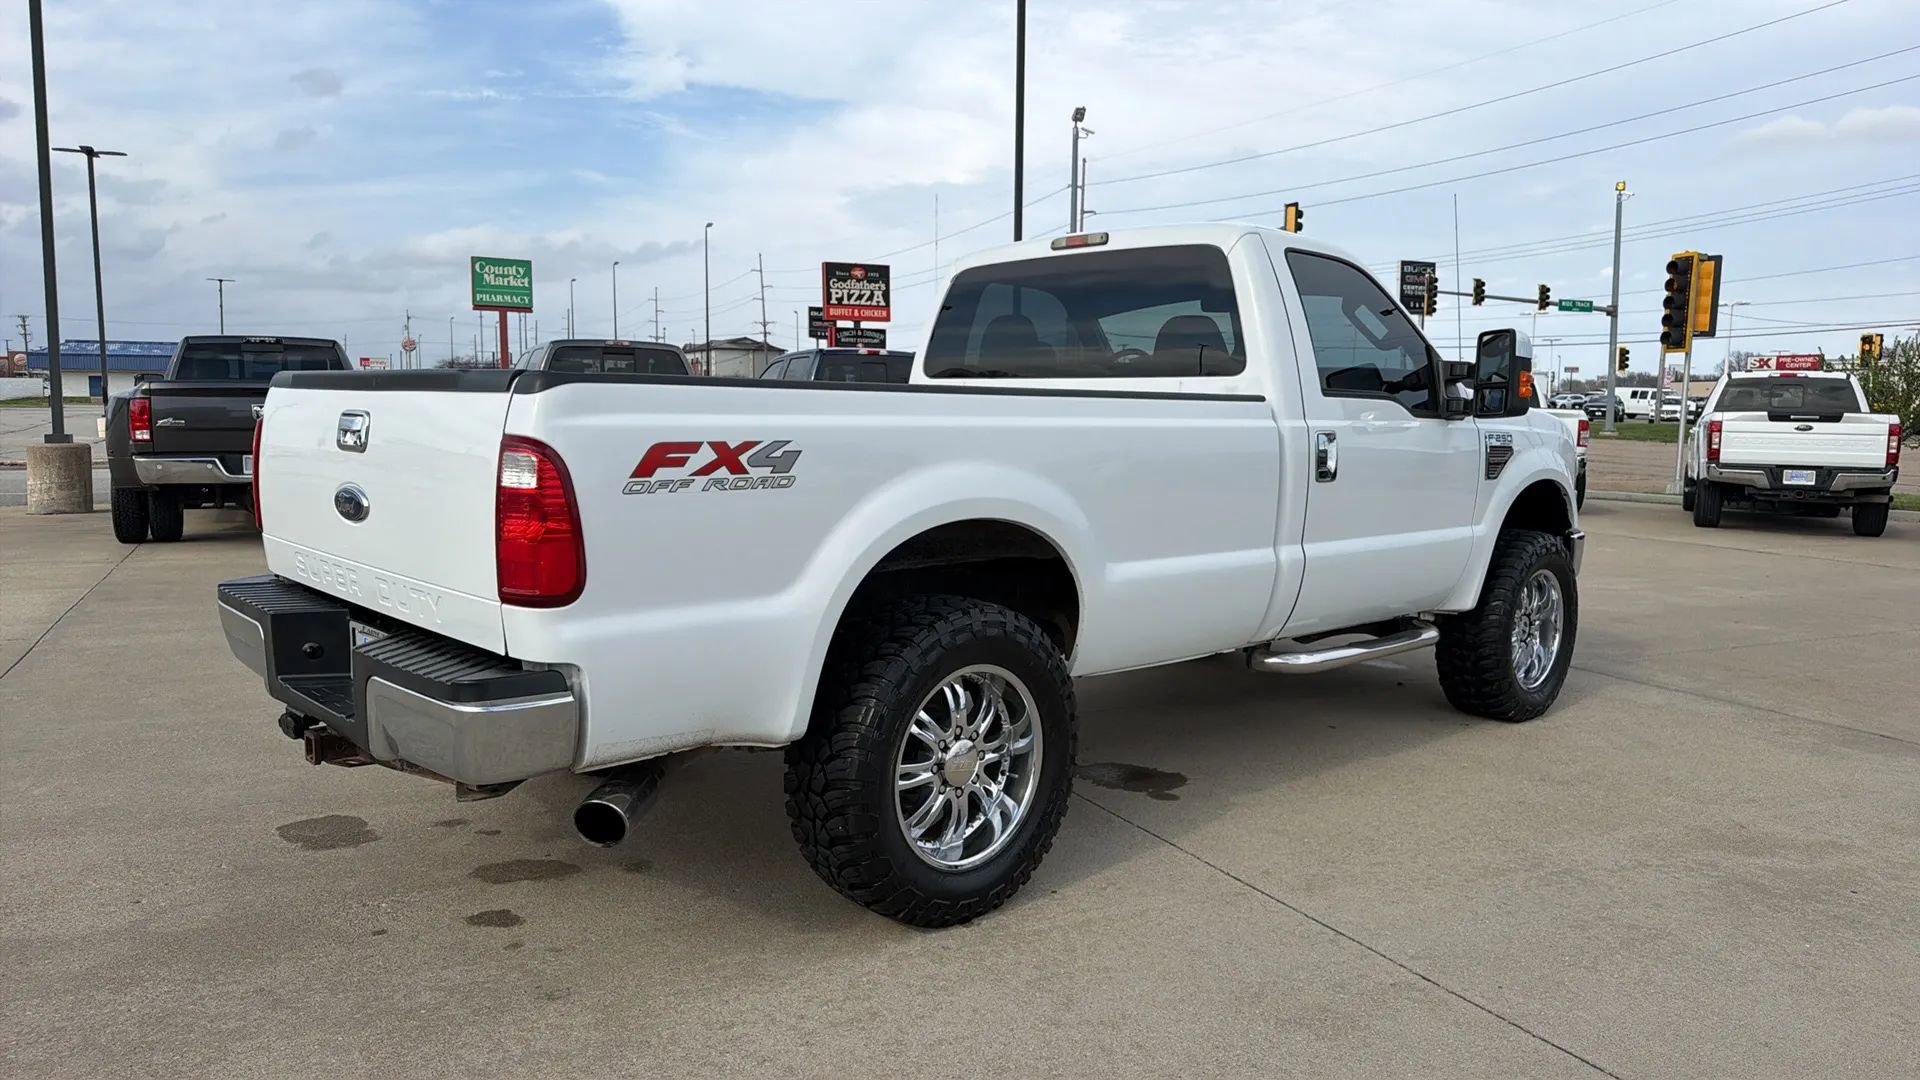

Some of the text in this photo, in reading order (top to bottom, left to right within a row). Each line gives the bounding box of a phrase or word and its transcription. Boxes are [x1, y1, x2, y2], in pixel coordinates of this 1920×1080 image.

[475, 261, 526, 277] County
[482, 273, 529, 287] Market
[829, 278, 886, 291] Godfather's
[476, 293, 530, 304] PHARMACY
[829, 289, 886, 306] PIZZA
[829, 308, 853, 317] BUFFET
[853, 309, 860, 317] &
[860, 309, 887, 318] CHICKEN
[628, 440, 803, 479] FX4
[622, 475, 797, 495] OFF ROAD
[295, 551, 443, 624] SUPER DUTY
